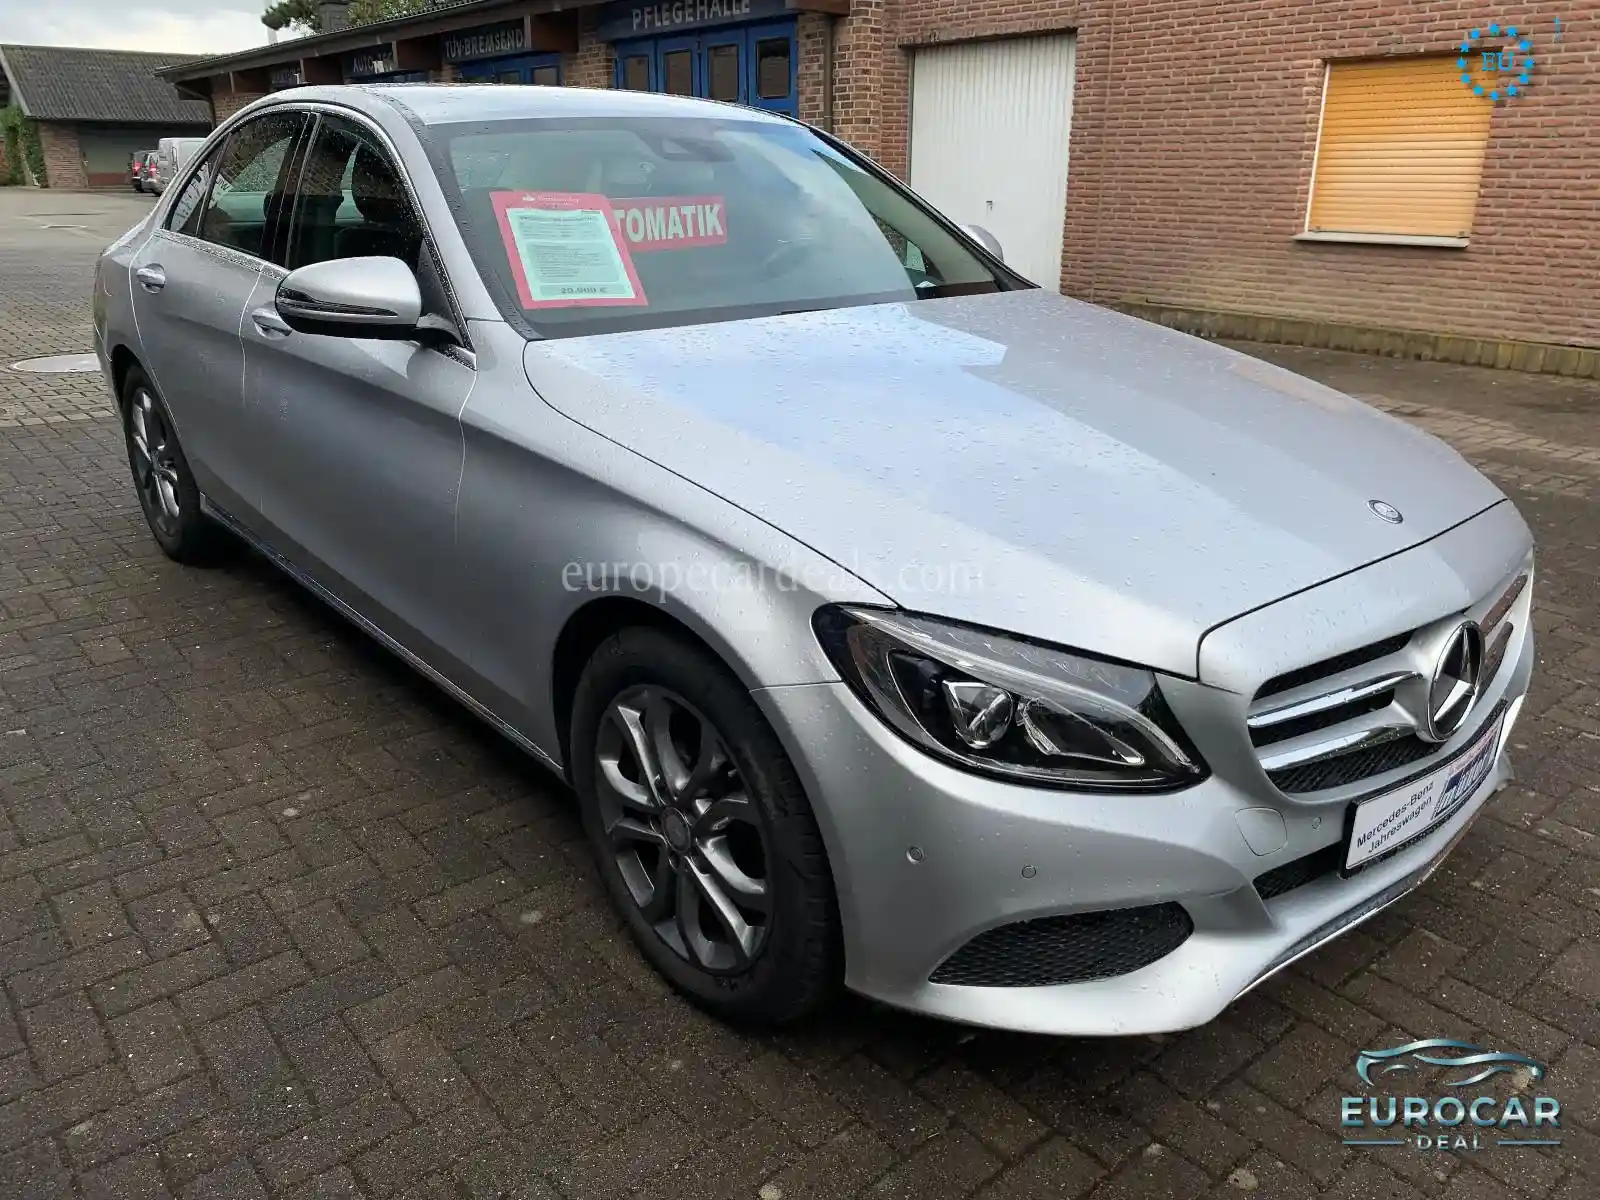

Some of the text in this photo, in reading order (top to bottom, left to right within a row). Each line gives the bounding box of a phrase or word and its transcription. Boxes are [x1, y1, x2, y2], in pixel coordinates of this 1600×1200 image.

[632, 0, 750, 31] PFLEGEHALLE
[1357, 780, 1434, 848] Mercedes-Benz
[1367, 795, 1432, 853] Jahreswagen
